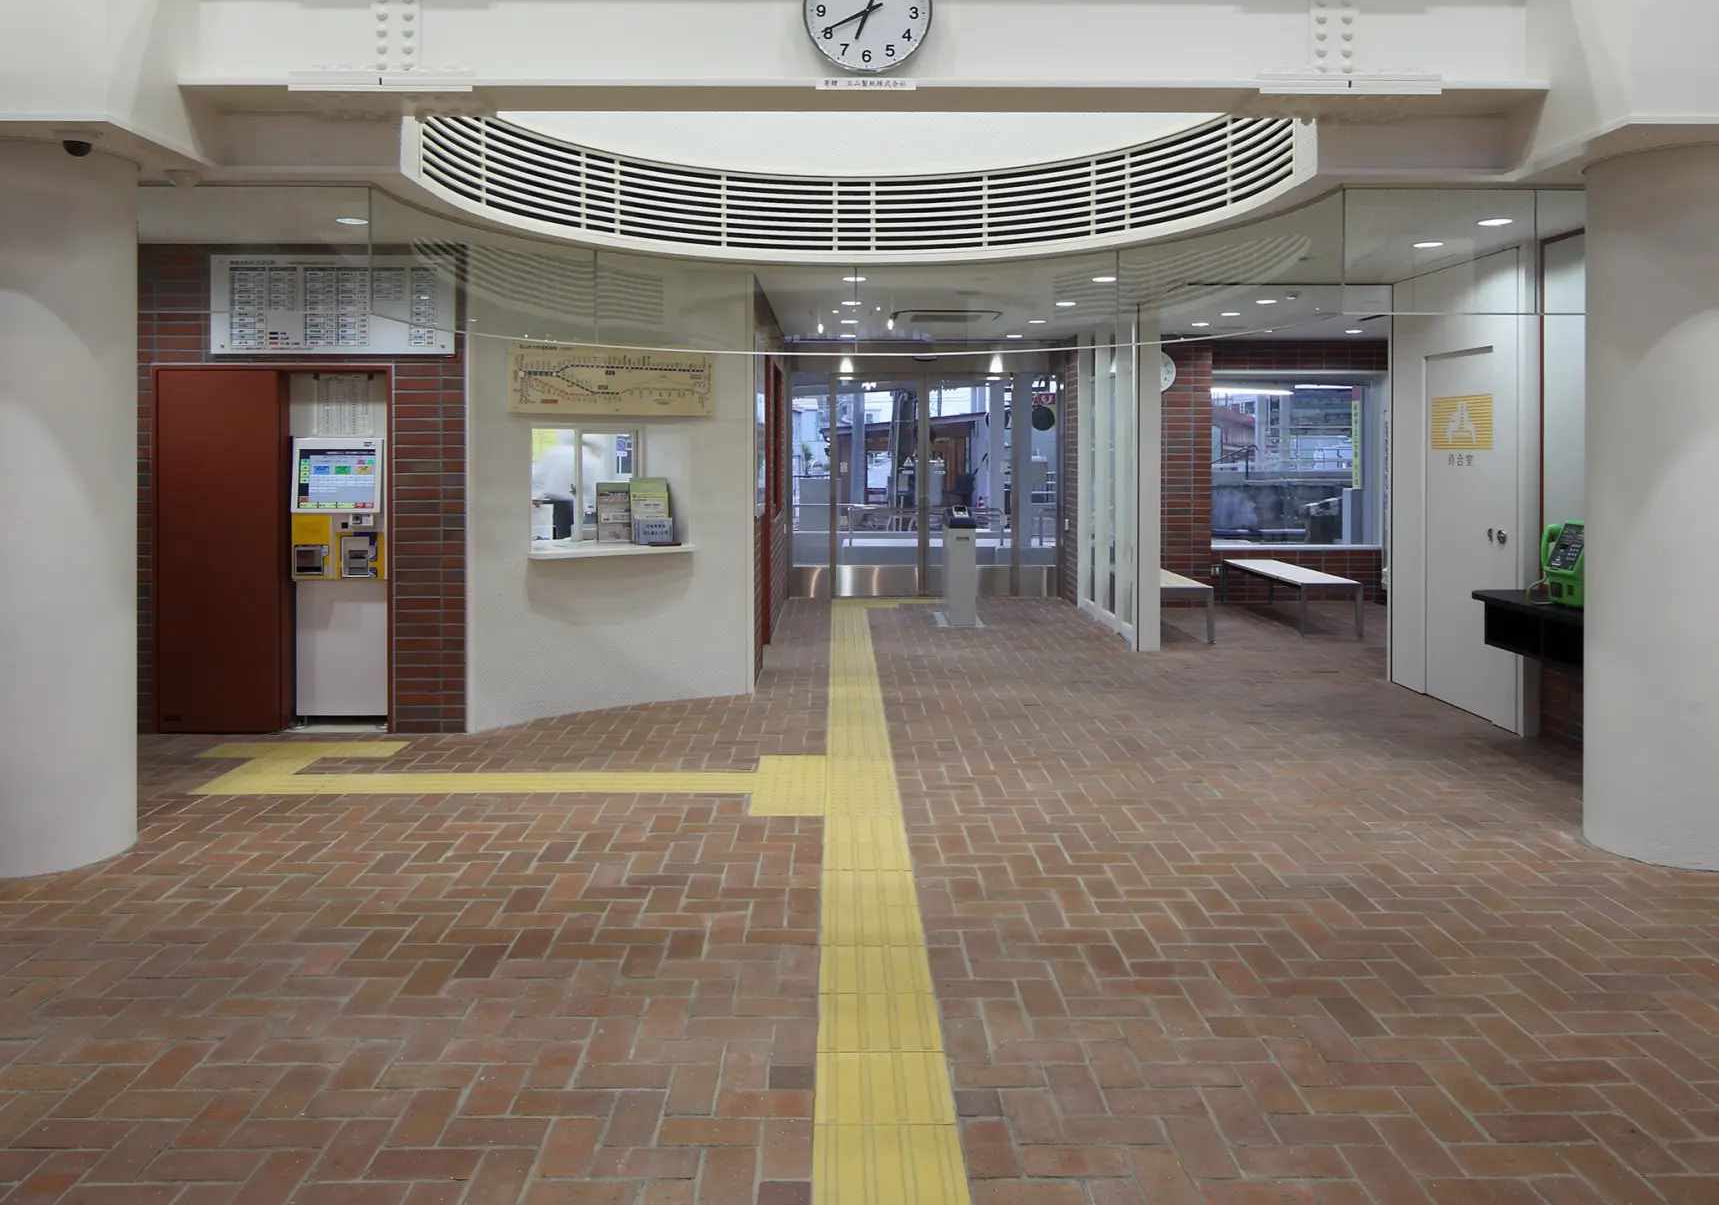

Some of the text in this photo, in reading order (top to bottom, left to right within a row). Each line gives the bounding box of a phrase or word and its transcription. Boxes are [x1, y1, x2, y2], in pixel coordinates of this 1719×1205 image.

[816, 4, 826, 17] 9
[909, 7, 919, 19] 3
[823, 27, 833, 40] 8
[901, 28, 912, 42] 4
[839, 43, 849, 56] 7
[861, 49, 872, 63] 6
[885, 44, 895, 57] 5
